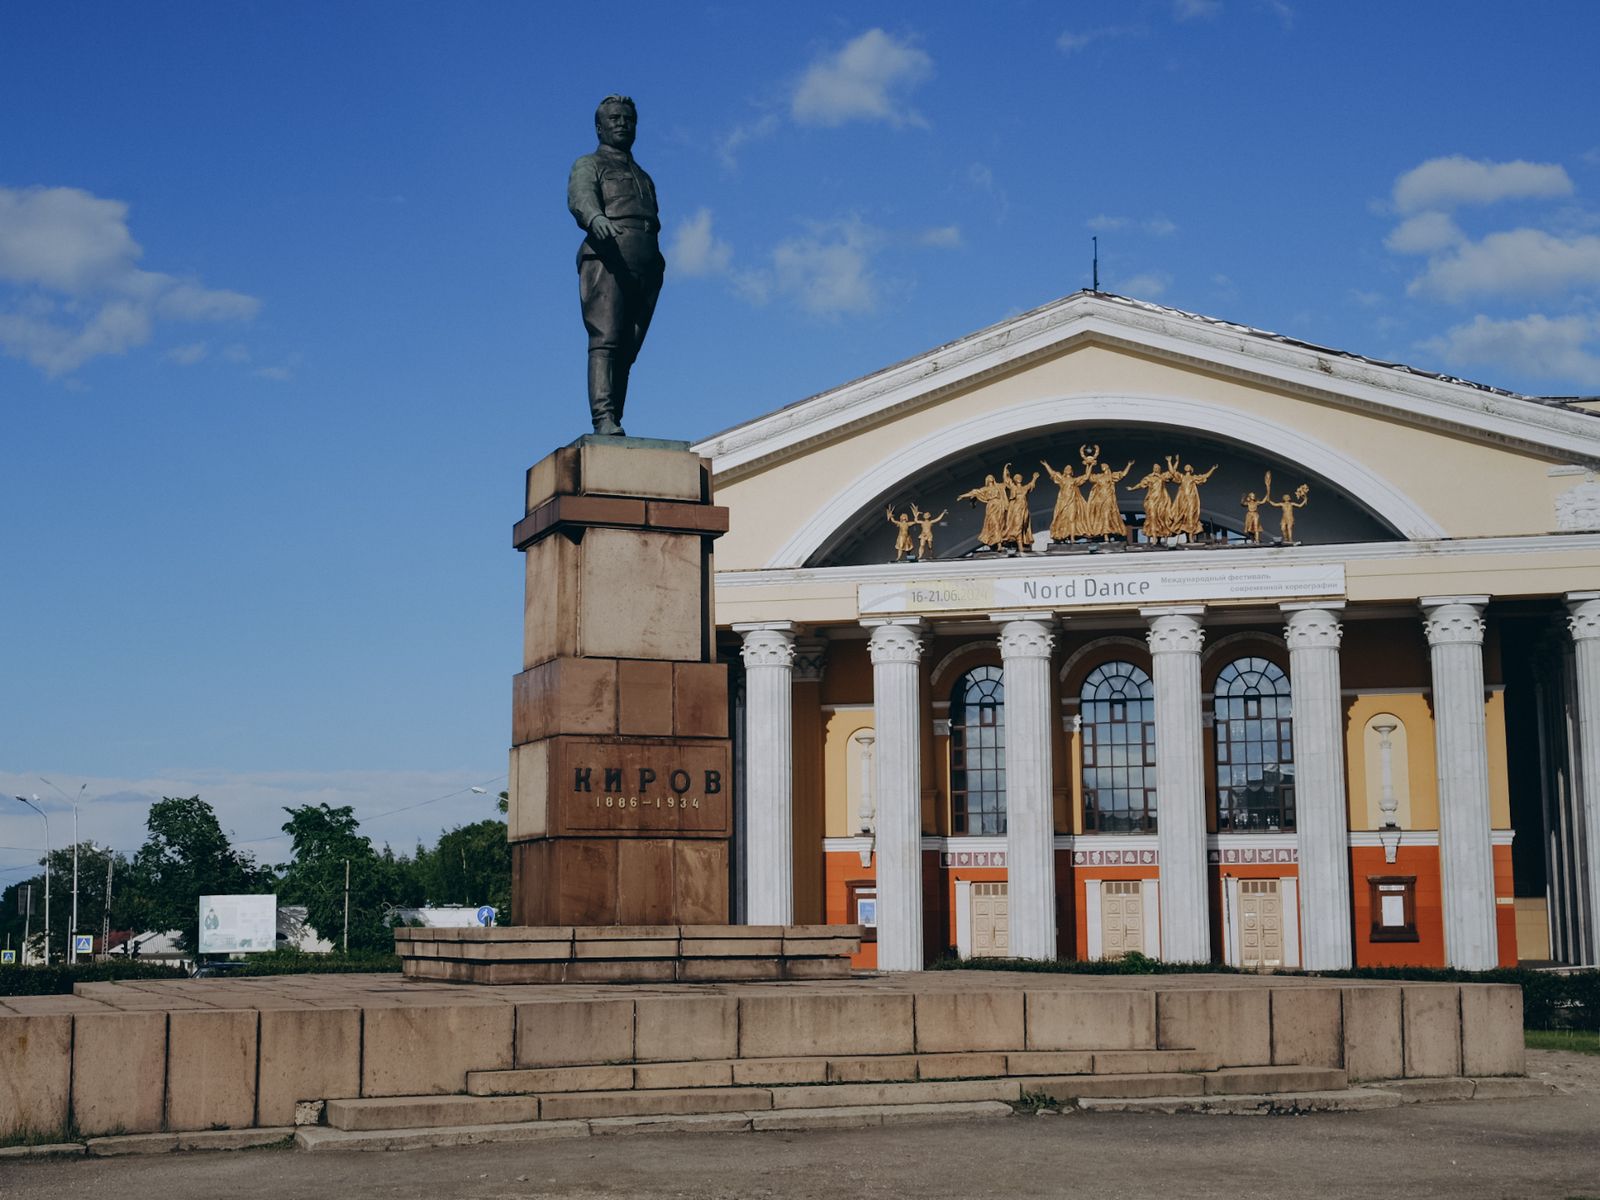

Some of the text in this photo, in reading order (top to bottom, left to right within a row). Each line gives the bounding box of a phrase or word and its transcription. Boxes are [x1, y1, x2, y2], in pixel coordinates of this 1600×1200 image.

[1024, 578, 1149, 599] Nord Dance
[574, 767, 721, 794] КИРОВ
